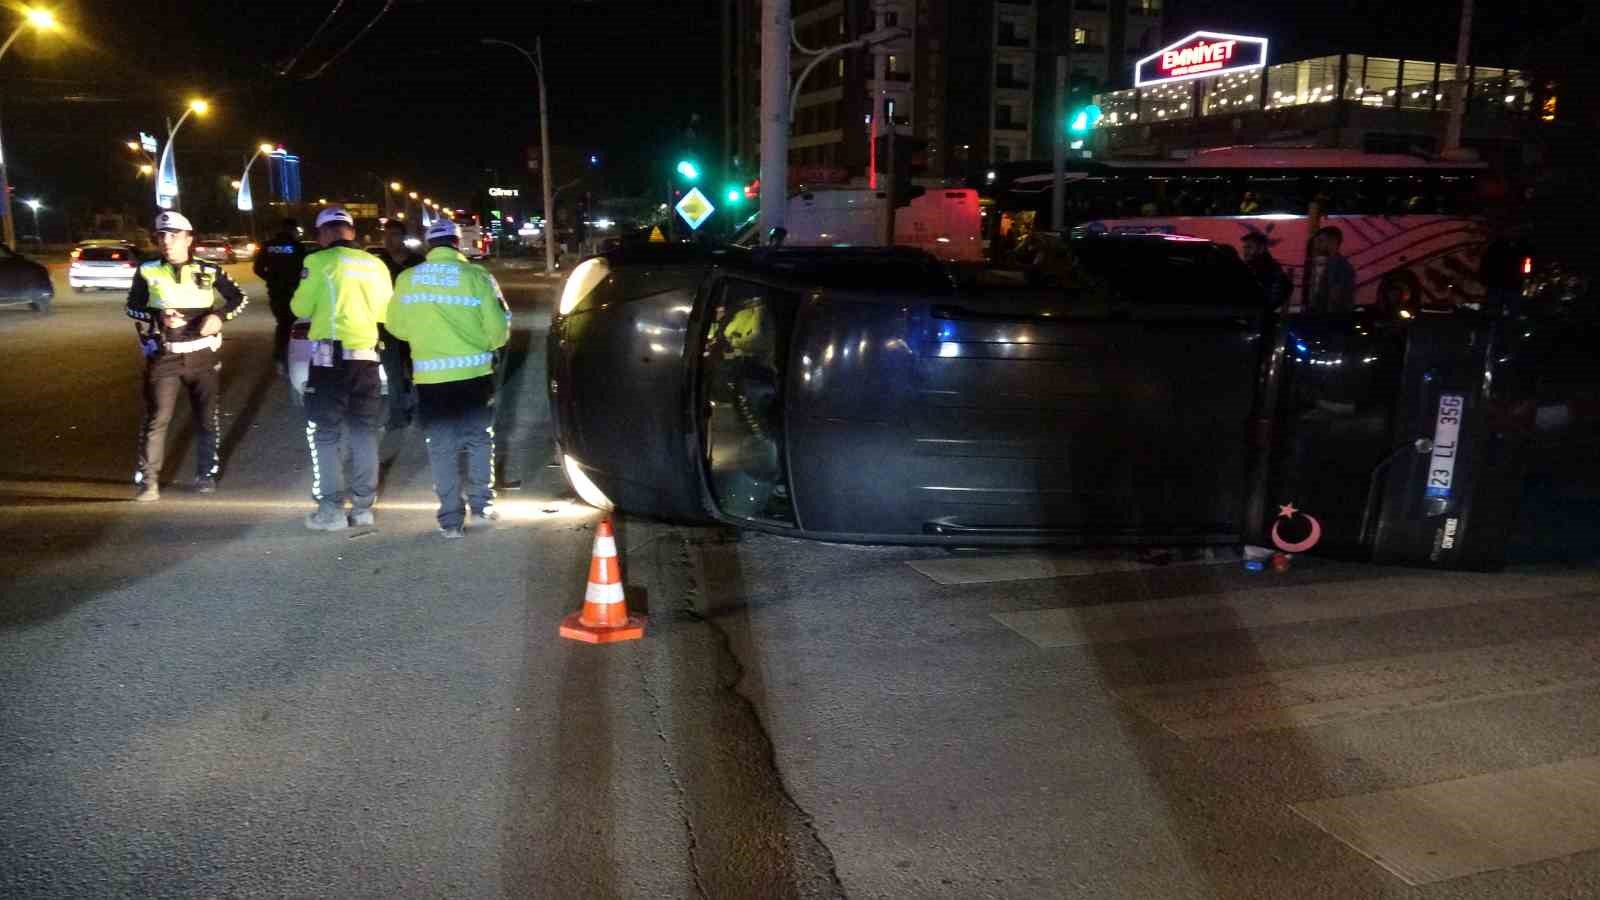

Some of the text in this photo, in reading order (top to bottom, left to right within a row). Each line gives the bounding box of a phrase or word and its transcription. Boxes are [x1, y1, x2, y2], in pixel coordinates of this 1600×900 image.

[1162, 41, 1236, 69] EMNİYET
[1435, 441, 1456, 458] LL
[1431, 469, 1449, 487] 23
